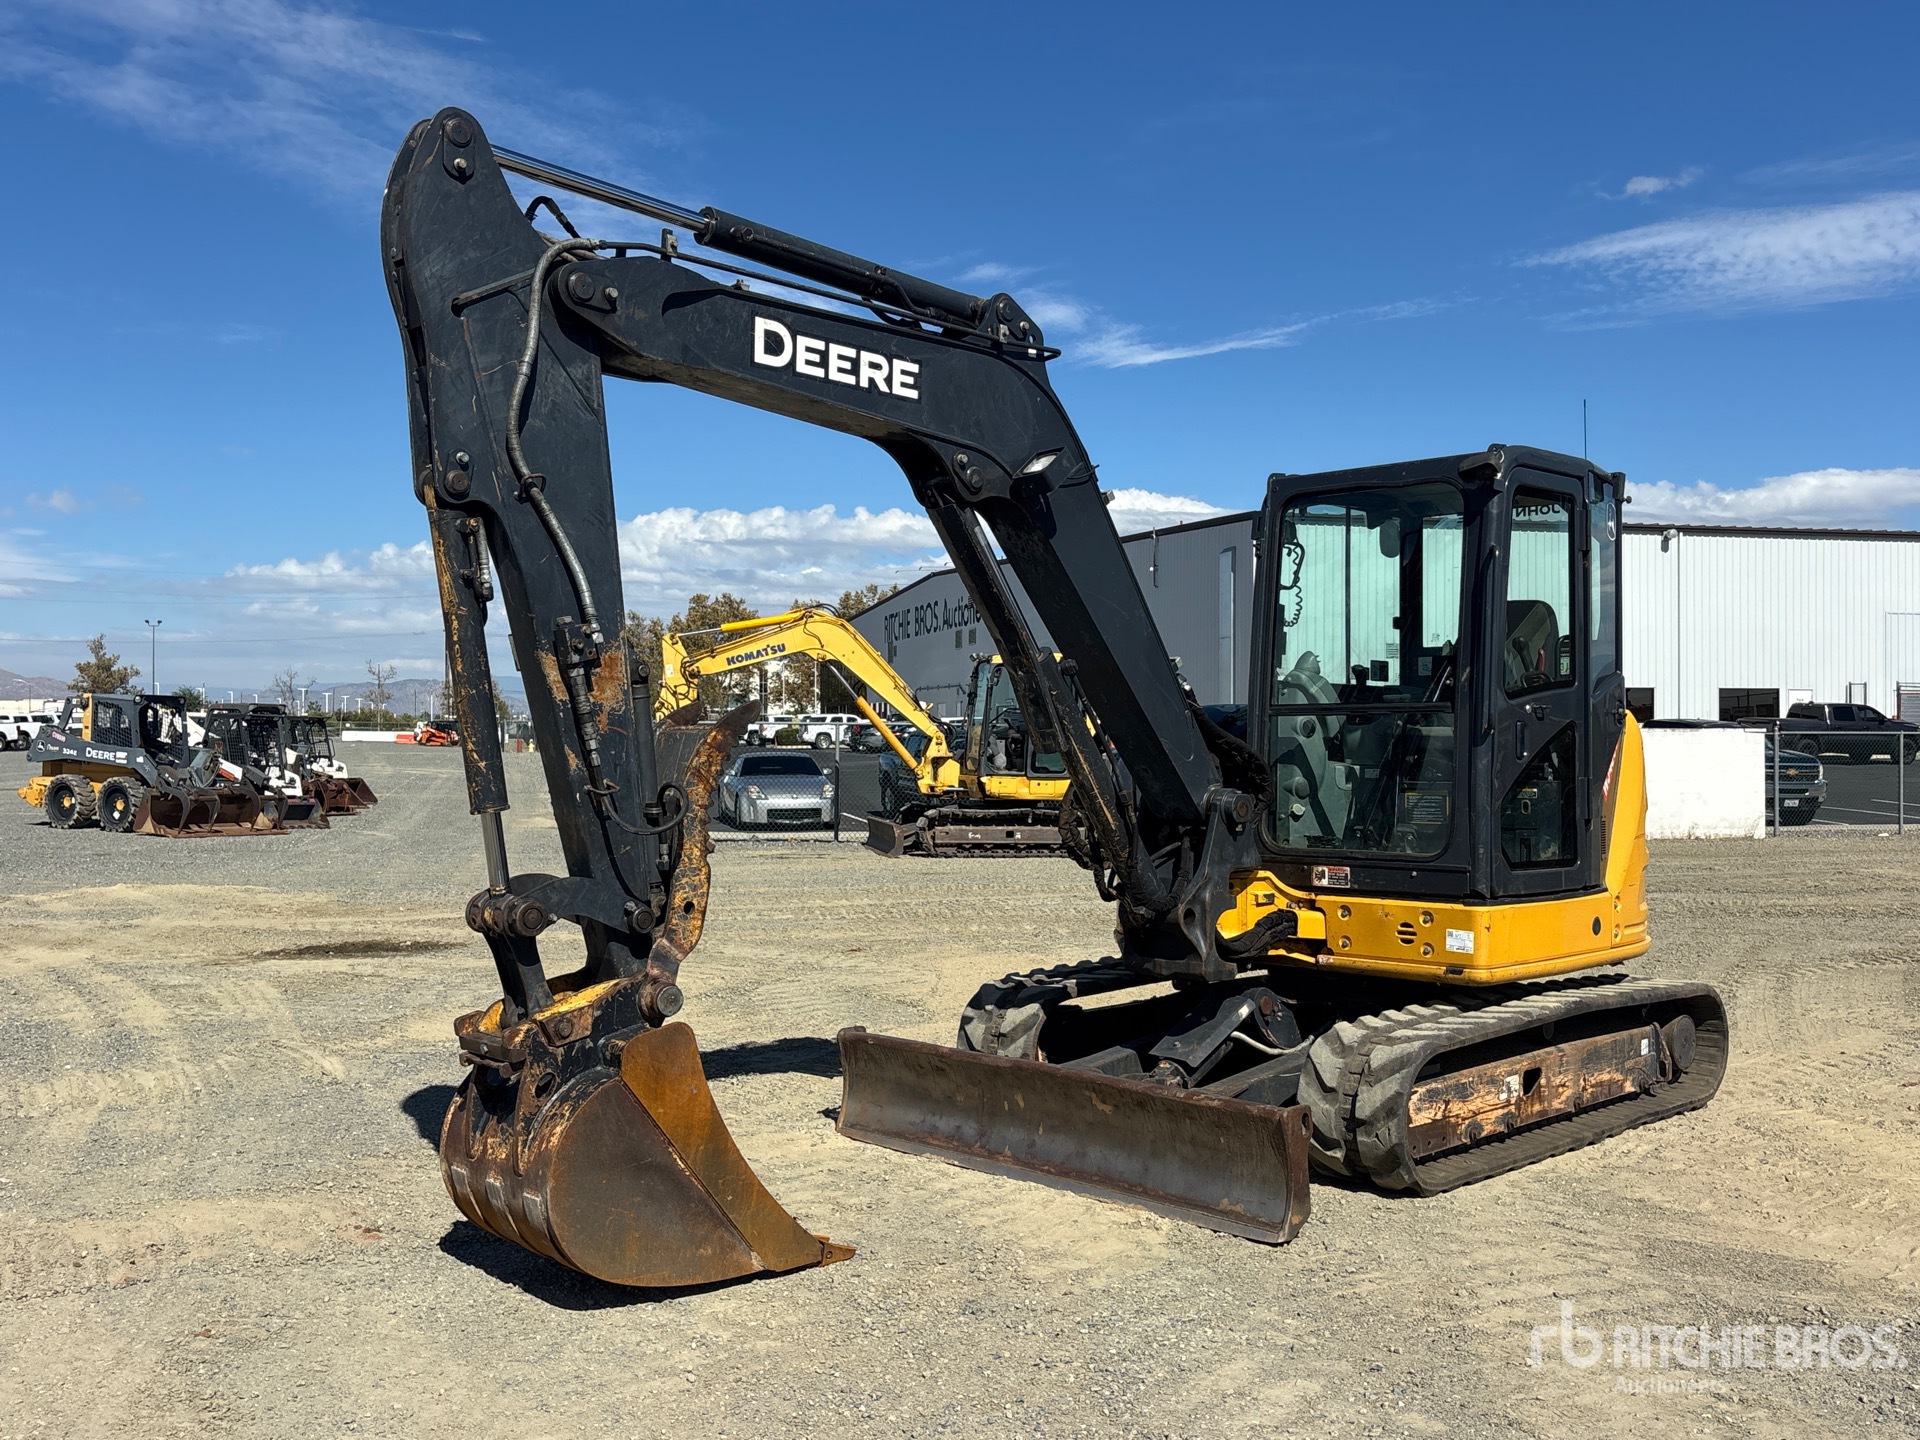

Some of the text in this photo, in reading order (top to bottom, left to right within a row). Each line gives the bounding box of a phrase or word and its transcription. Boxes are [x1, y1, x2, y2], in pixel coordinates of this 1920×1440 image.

[754, 316, 919, 399] DEERE
[884, 608, 911, 643] RITCHIE
[914, 600, 941, 637] BROS.
[726, 643, 786, 666] KOMATSU
[85, 747, 115, 760] DEERE
